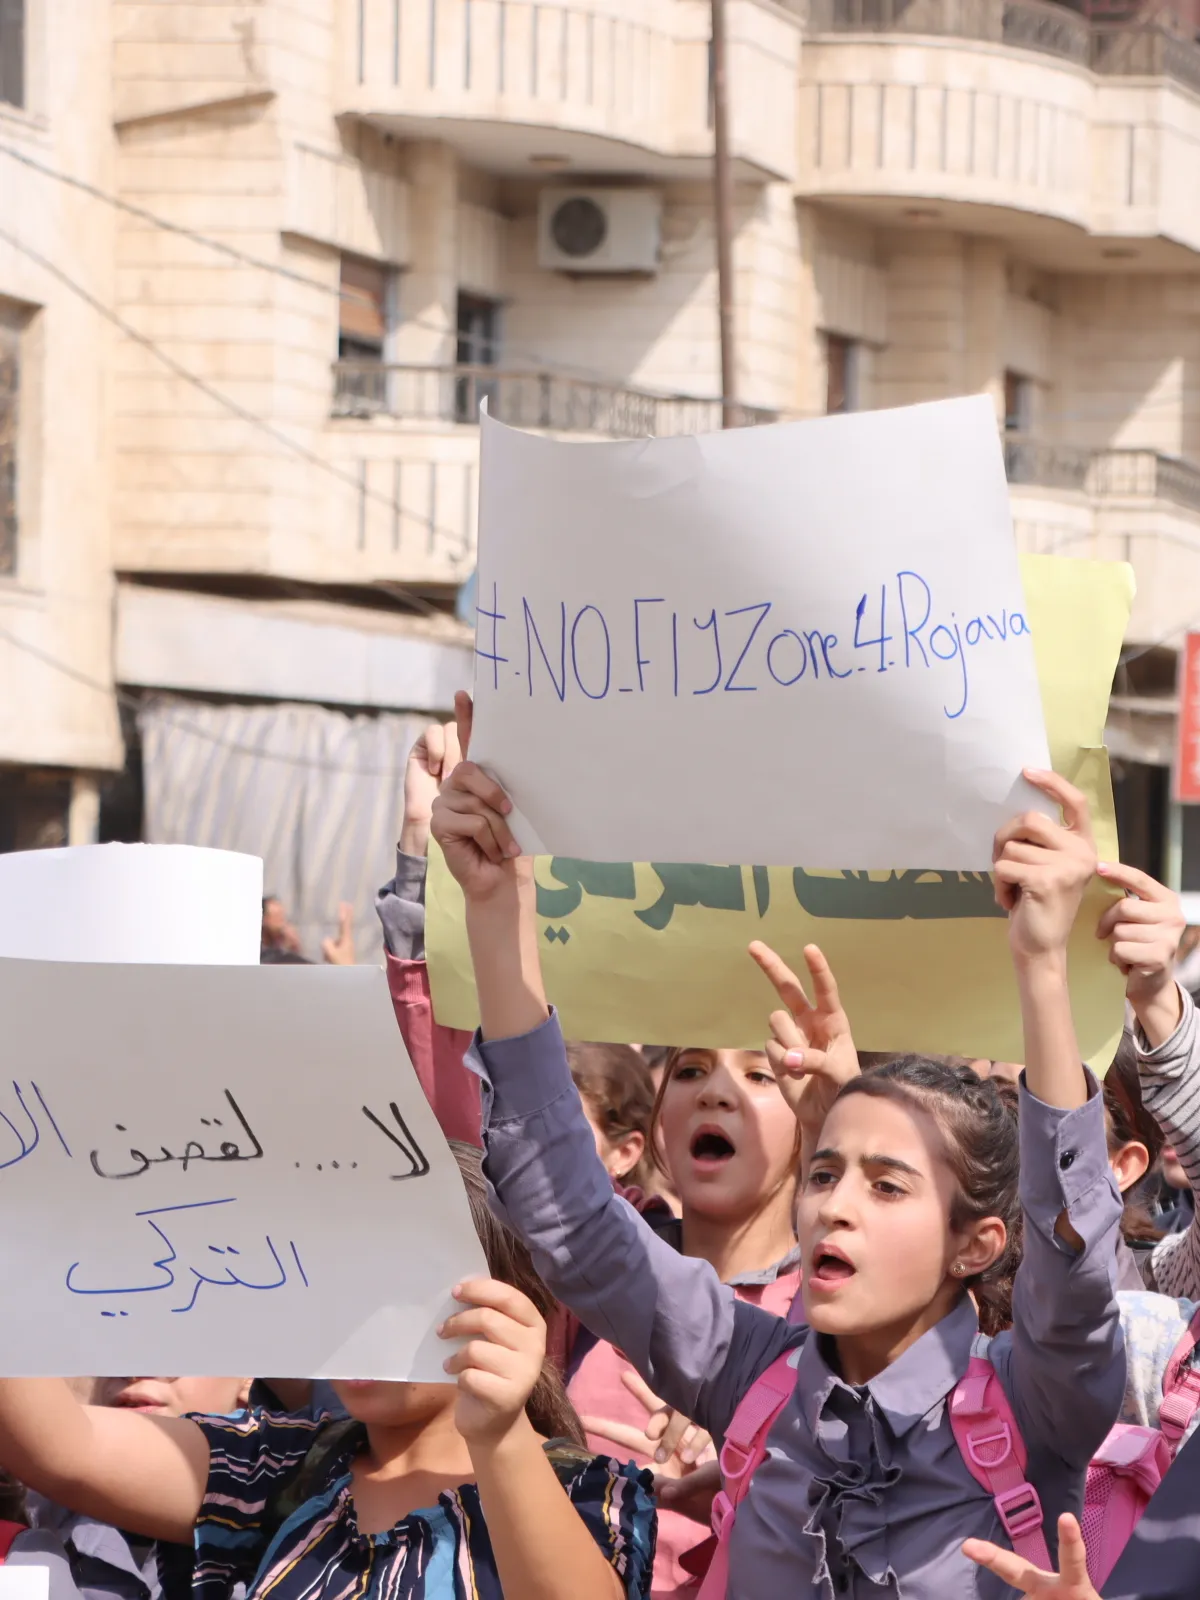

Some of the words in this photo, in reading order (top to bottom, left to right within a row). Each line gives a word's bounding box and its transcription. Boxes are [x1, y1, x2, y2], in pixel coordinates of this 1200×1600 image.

[89, 1088, 265, 1181] لقصف
[362, 1102, 431, 1181] لا
[65, 1197, 310, 1318] التركي
